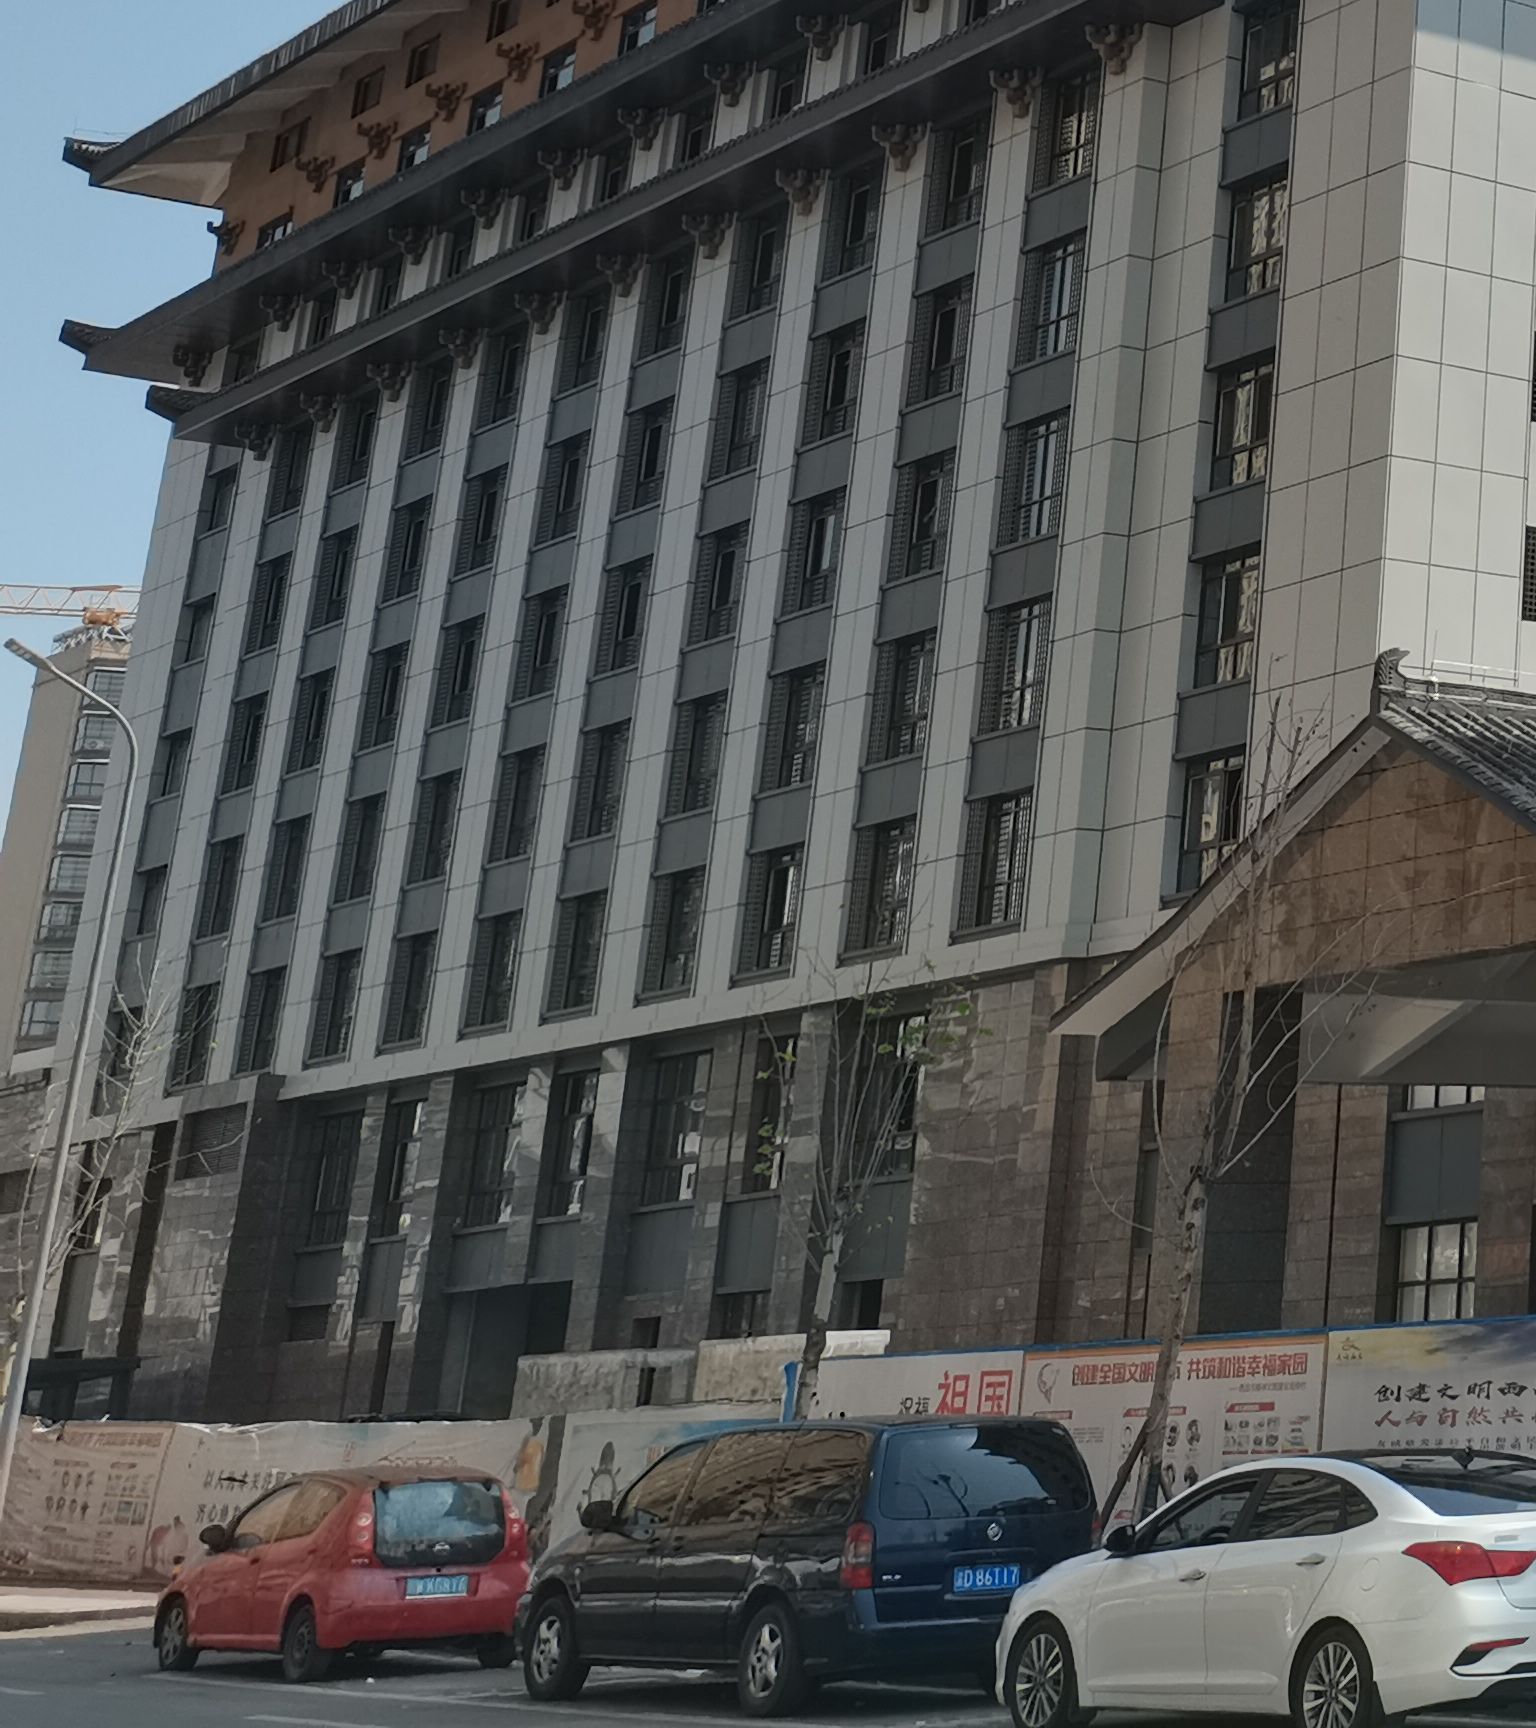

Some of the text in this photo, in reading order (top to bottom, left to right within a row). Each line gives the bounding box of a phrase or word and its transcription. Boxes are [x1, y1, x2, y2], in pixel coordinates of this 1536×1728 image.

[1187, 1352, 1308, 1380] 共筑和谐幸福家园
